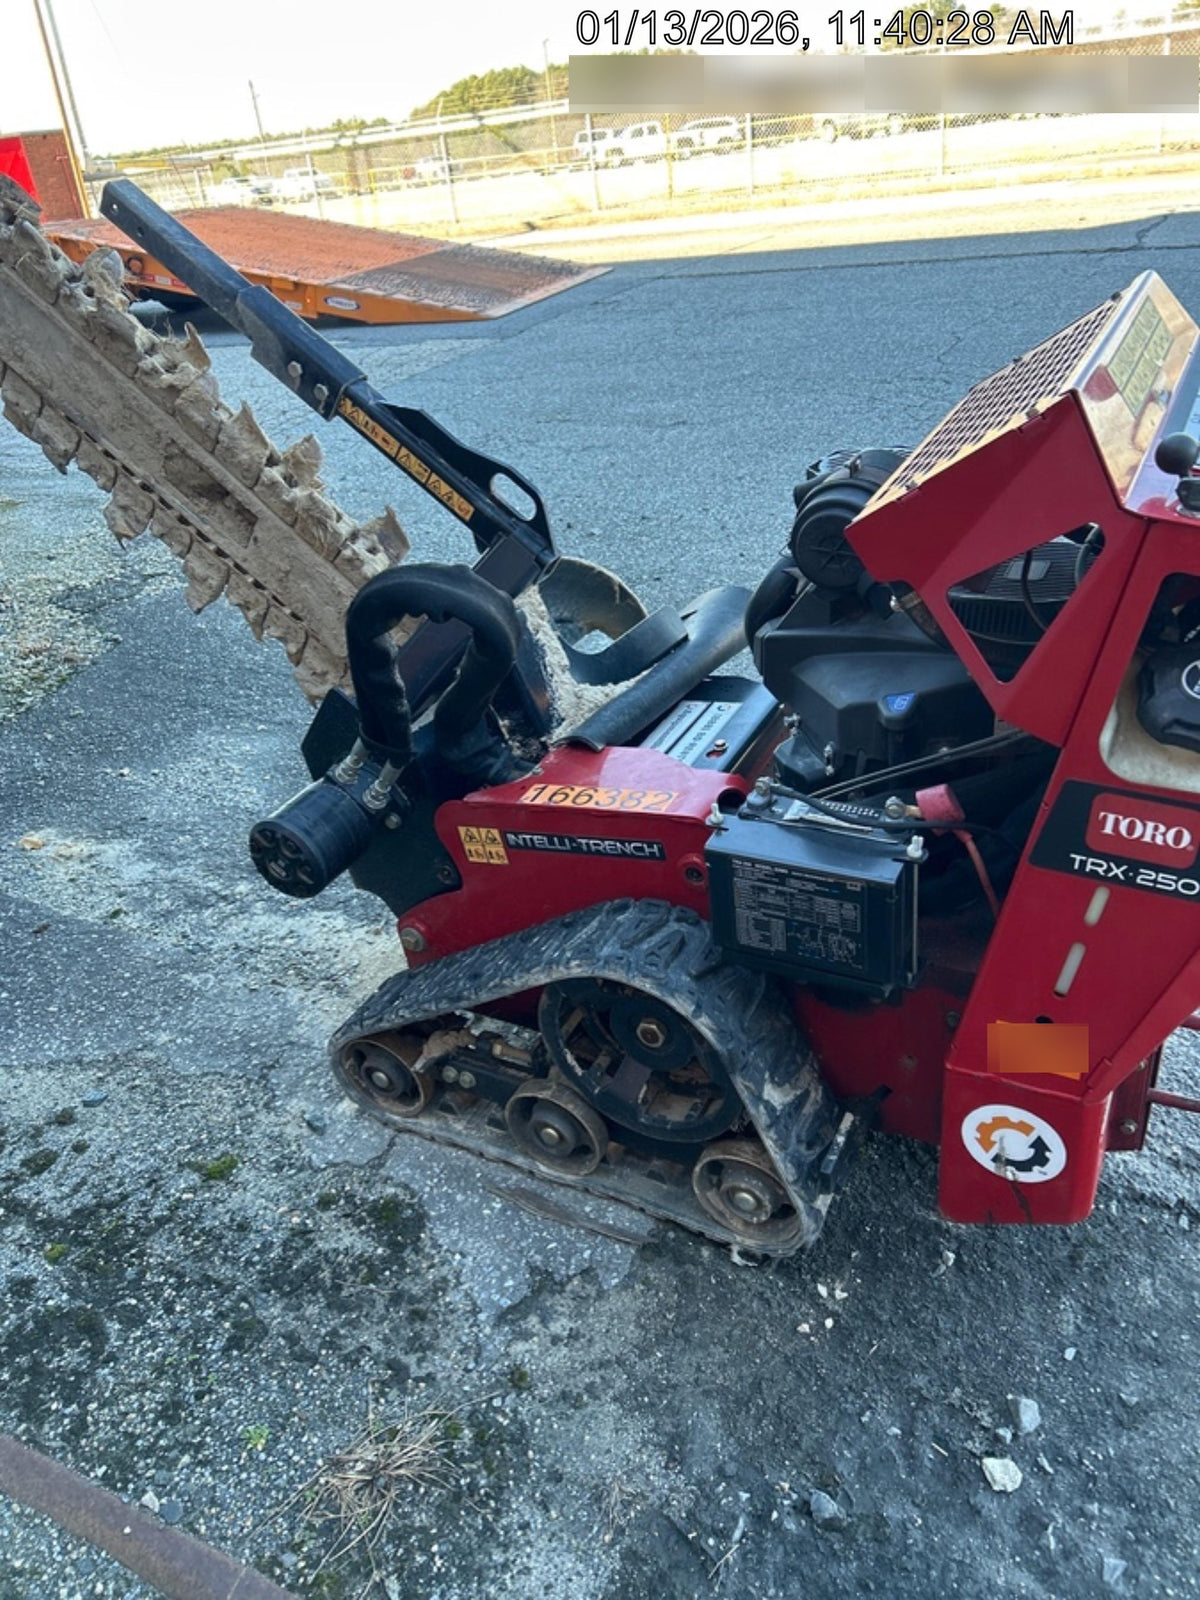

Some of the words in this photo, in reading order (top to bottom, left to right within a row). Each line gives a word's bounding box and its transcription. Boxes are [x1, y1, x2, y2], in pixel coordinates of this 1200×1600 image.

[530, 784, 674, 812] 166382
[1098, 811, 1192, 850] TORO
[506, 832, 661, 858] INTELLI-TRENCH
